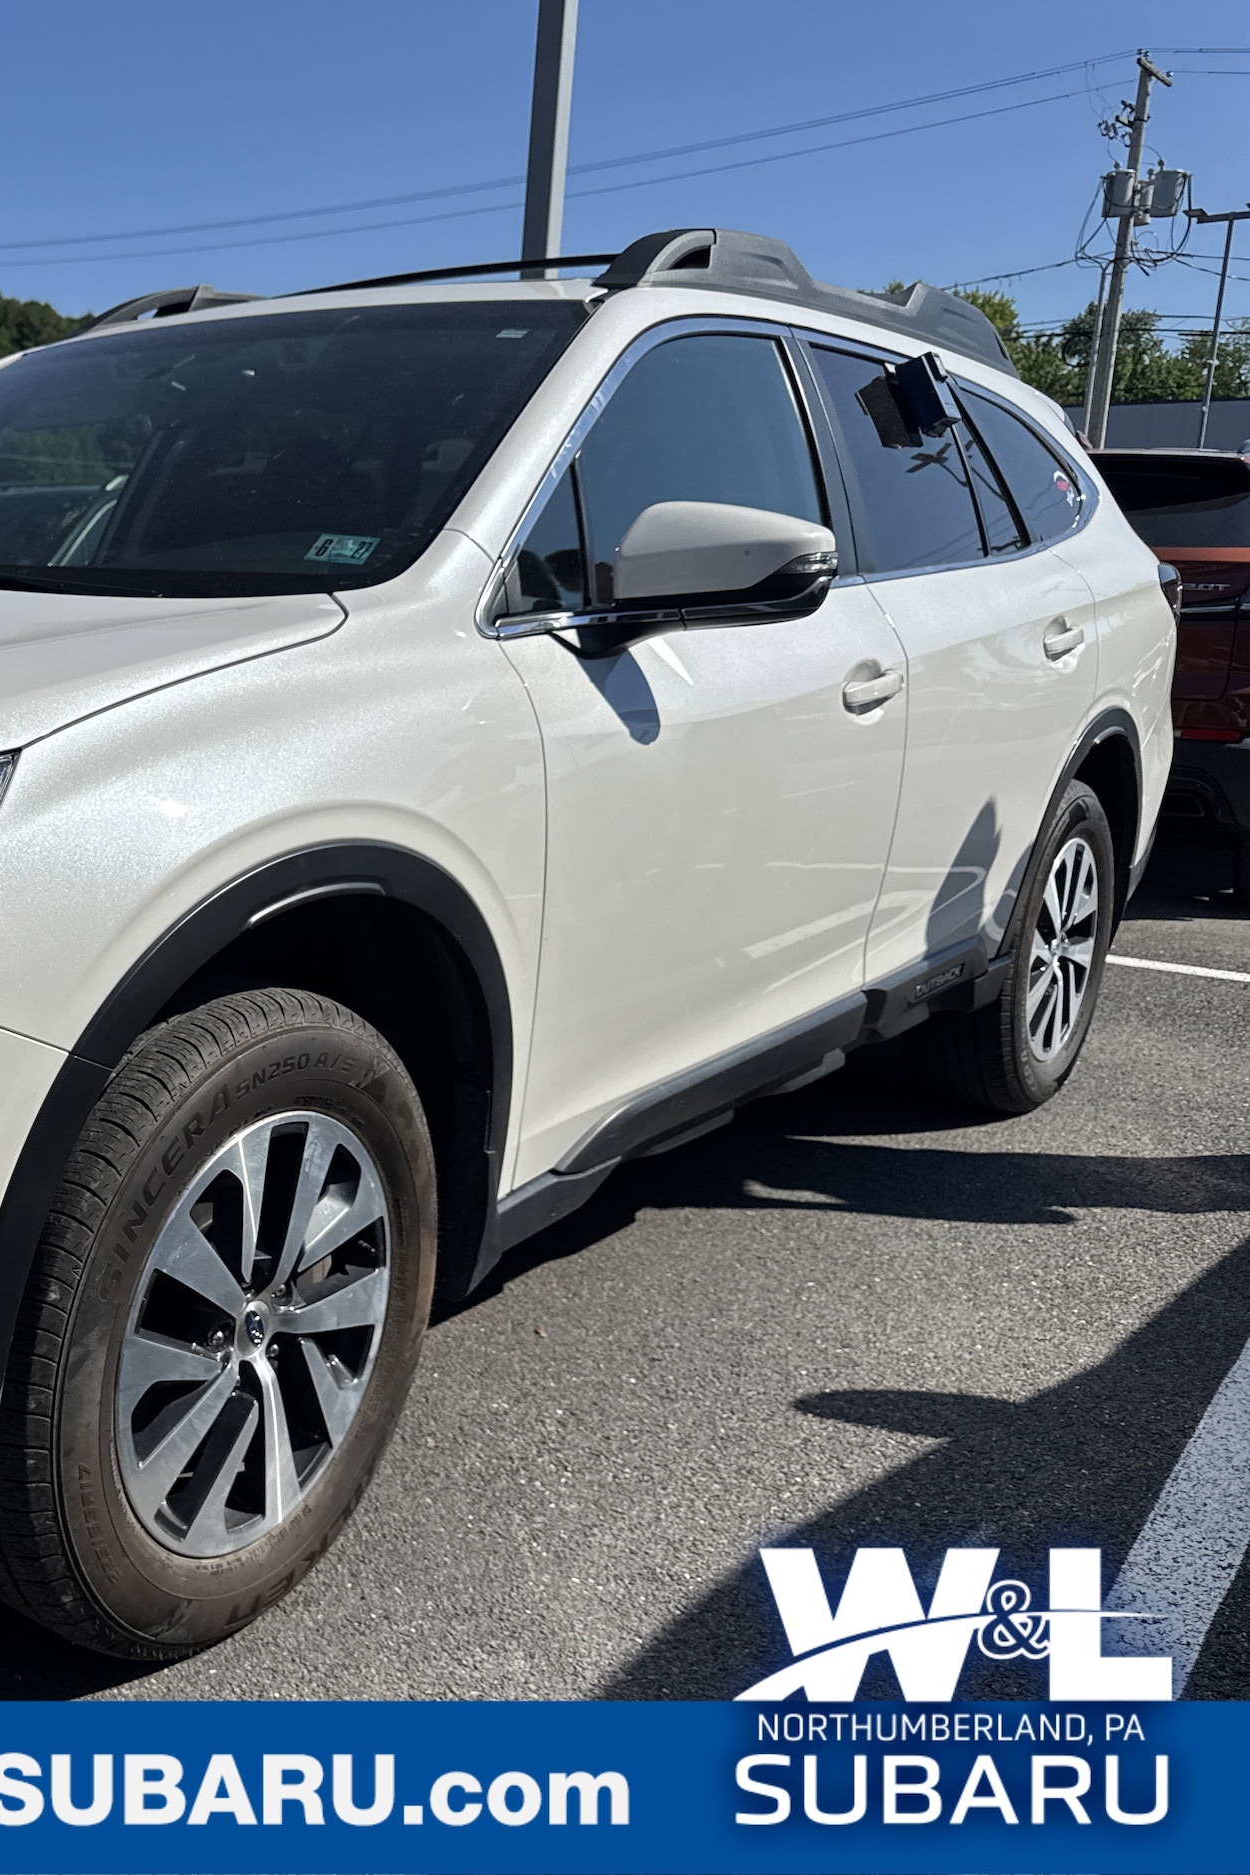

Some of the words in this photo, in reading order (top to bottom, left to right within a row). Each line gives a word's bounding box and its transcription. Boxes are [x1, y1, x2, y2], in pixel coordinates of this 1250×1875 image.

[314, 538, 335, 557] 6
[350, 540, 374, 560] 27
[914, 964, 962, 997] OUTBACK
[98, 1081, 232, 1301] SINCERA
[236, 1052, 310, 1101] SN250
